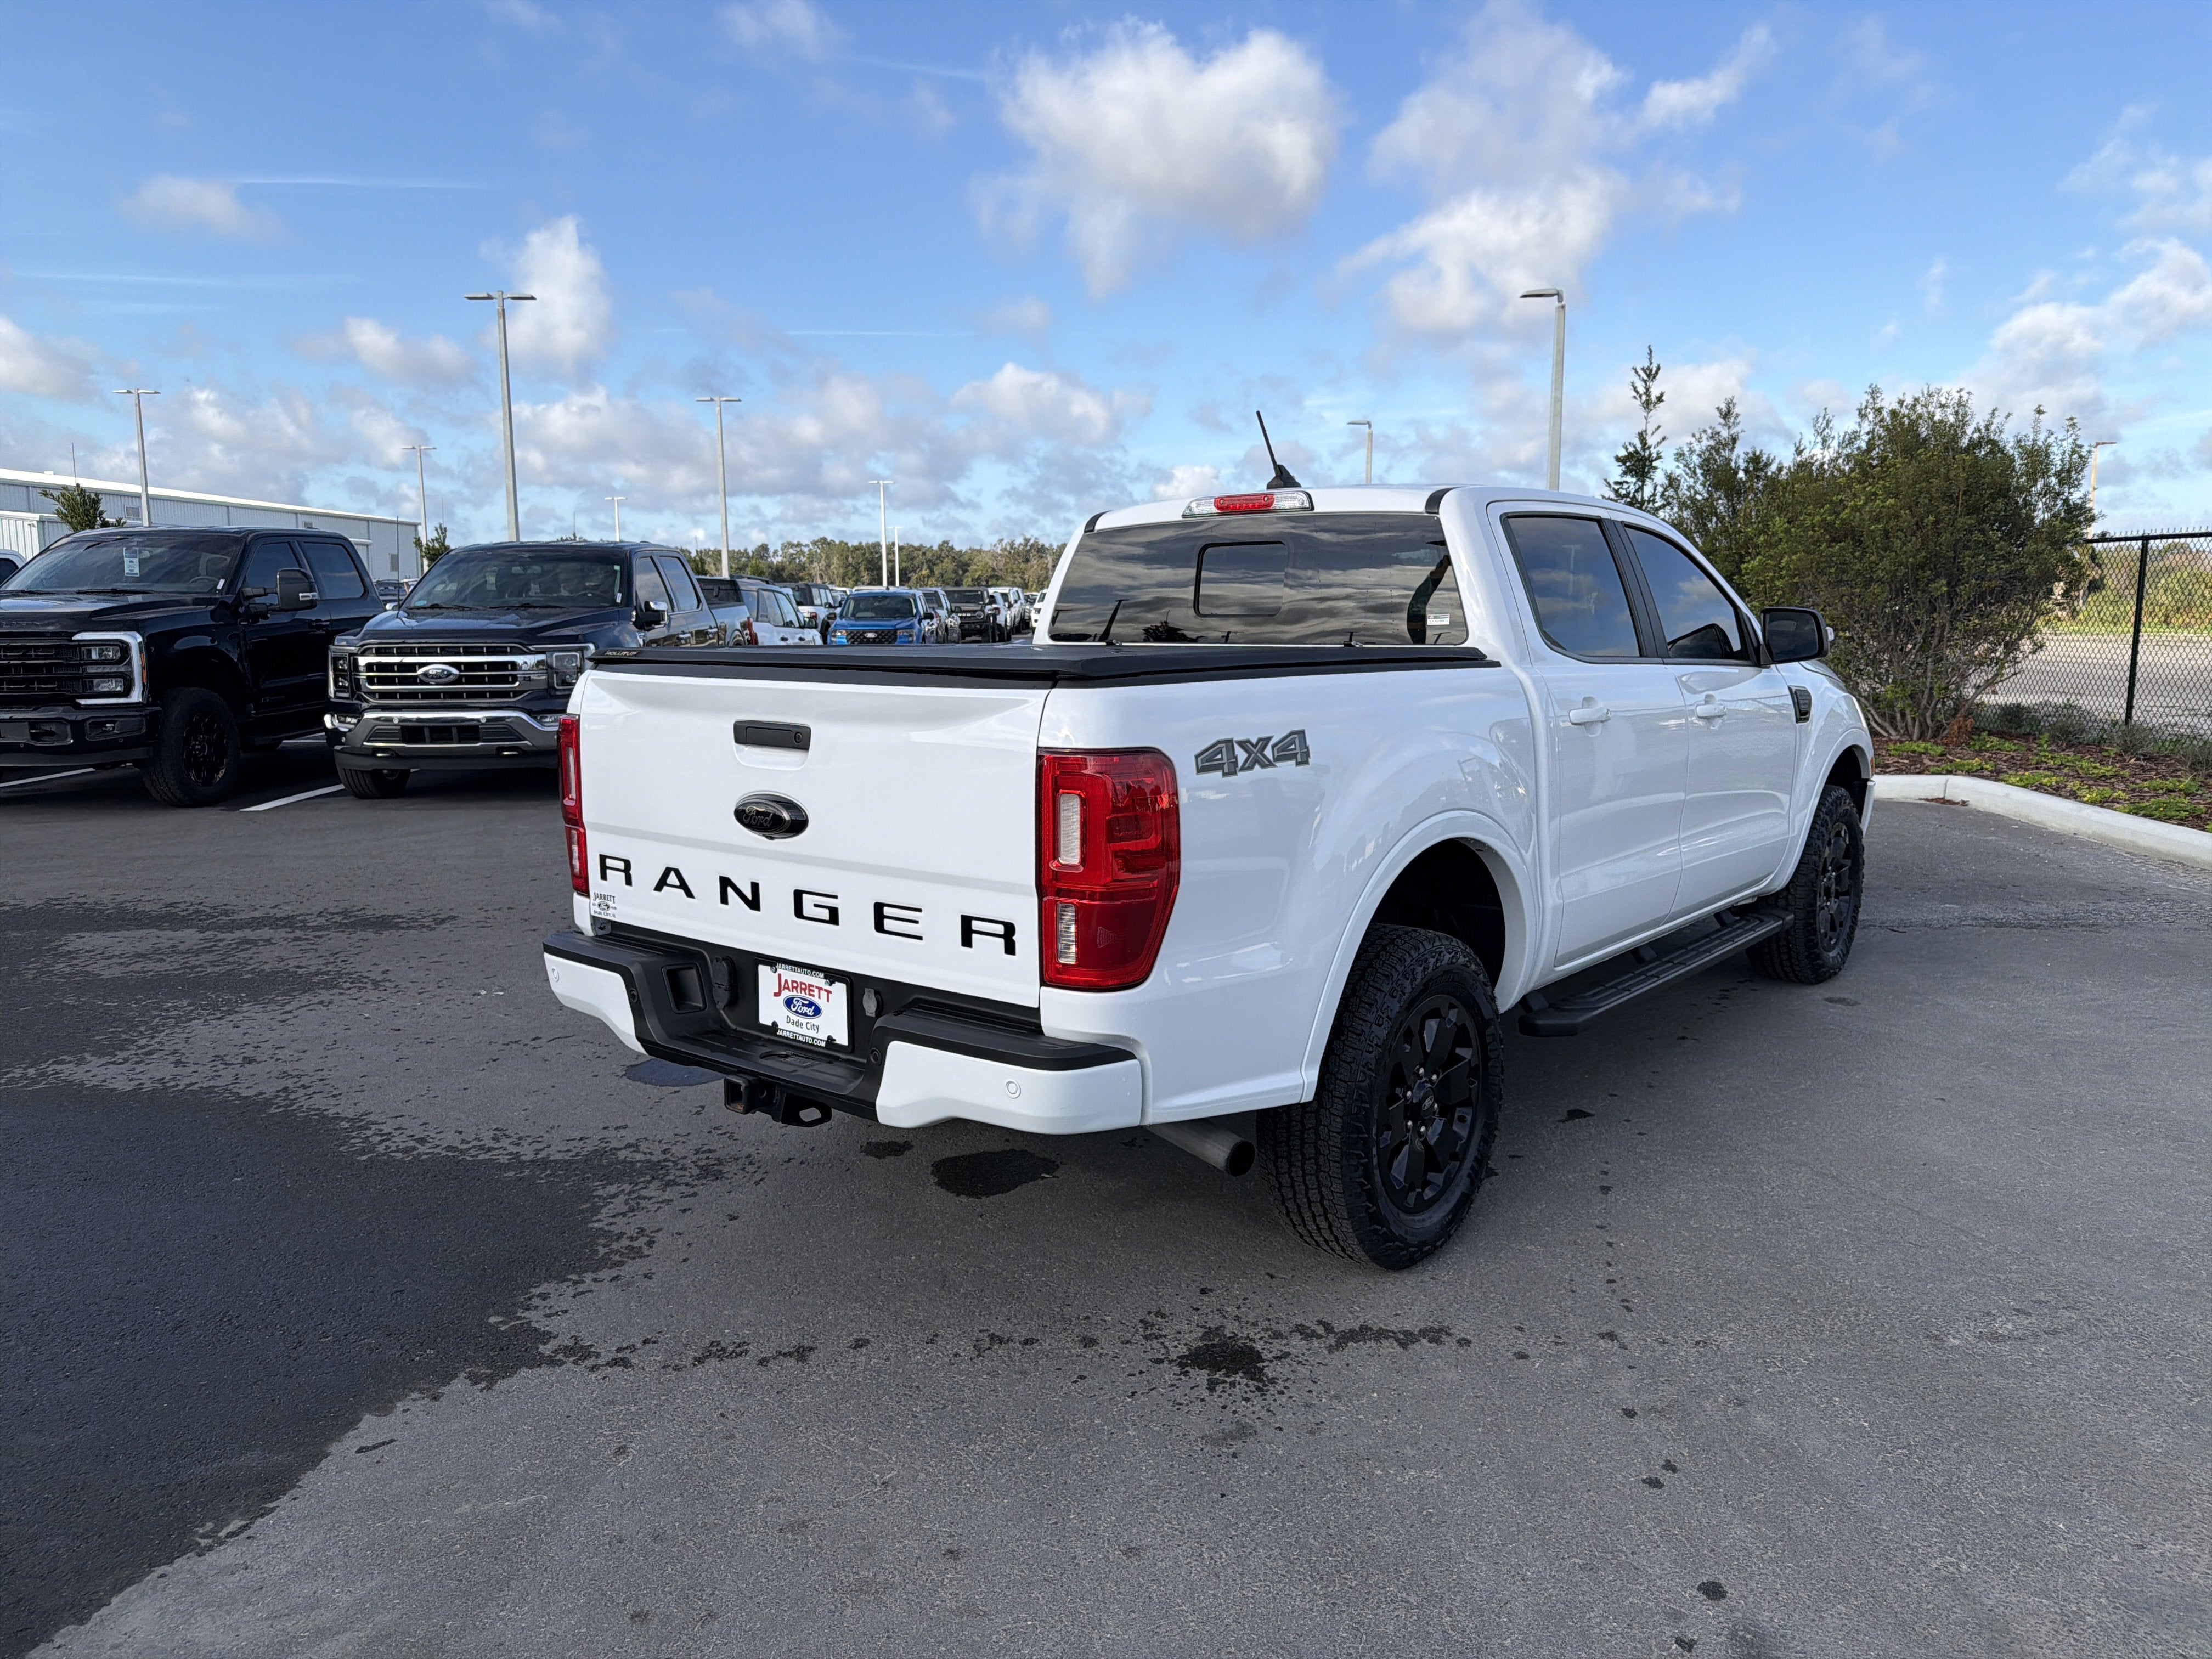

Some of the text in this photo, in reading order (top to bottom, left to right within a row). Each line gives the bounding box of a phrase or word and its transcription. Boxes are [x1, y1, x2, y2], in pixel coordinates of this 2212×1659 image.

[743, 805, 773, 827] Ford
[593, 892, 616, 904] JARRETT
[599, 853, 1017, 956] RANGER
[775, 962, 825, 978] JARRETTAUTO.COM
[773, 973, 832, 1003] JARRETT
[791, 997, 815, 1016] Ford
[786, 1015, 820, 1034] Dade City
[776, 1029, 826, 1047] JARRETTAUTO.COM
